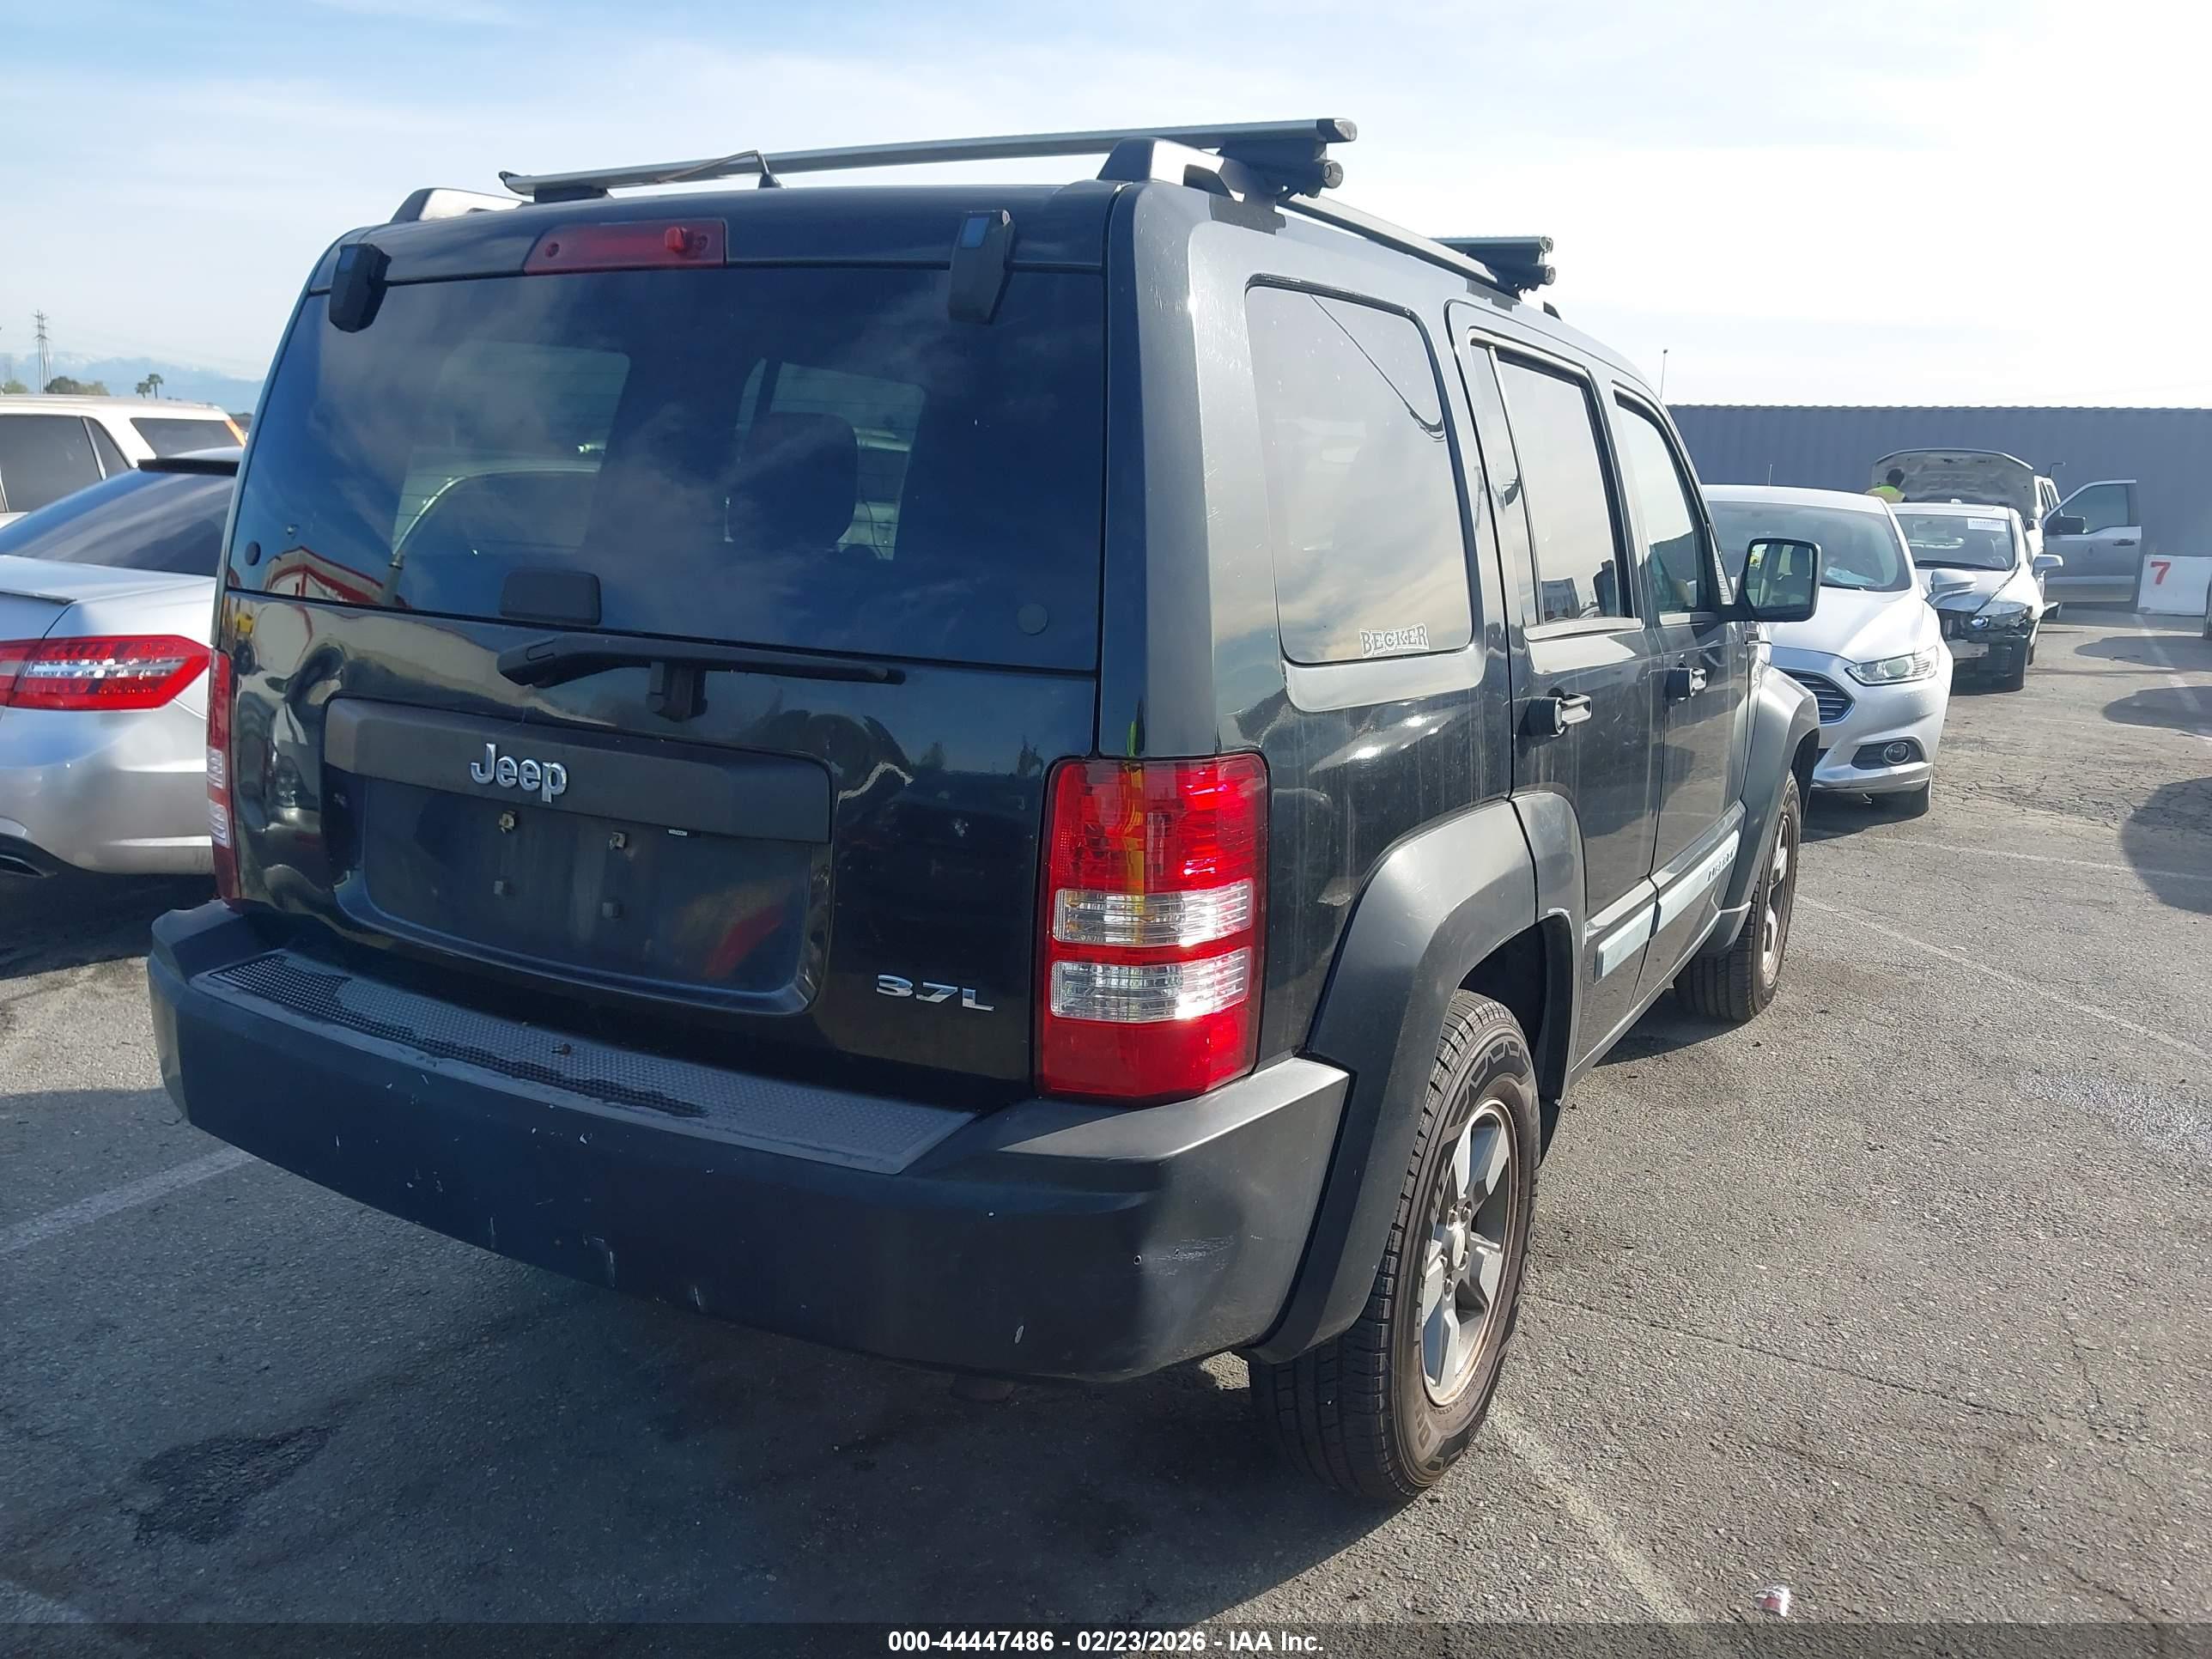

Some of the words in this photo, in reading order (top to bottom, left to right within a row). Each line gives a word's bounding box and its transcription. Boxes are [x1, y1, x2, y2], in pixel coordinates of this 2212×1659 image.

[2150, 561, 2172, 585] 7
[1359, 623, 1429, 657] BECKER
[470, 743, 568, 804] Jeep
